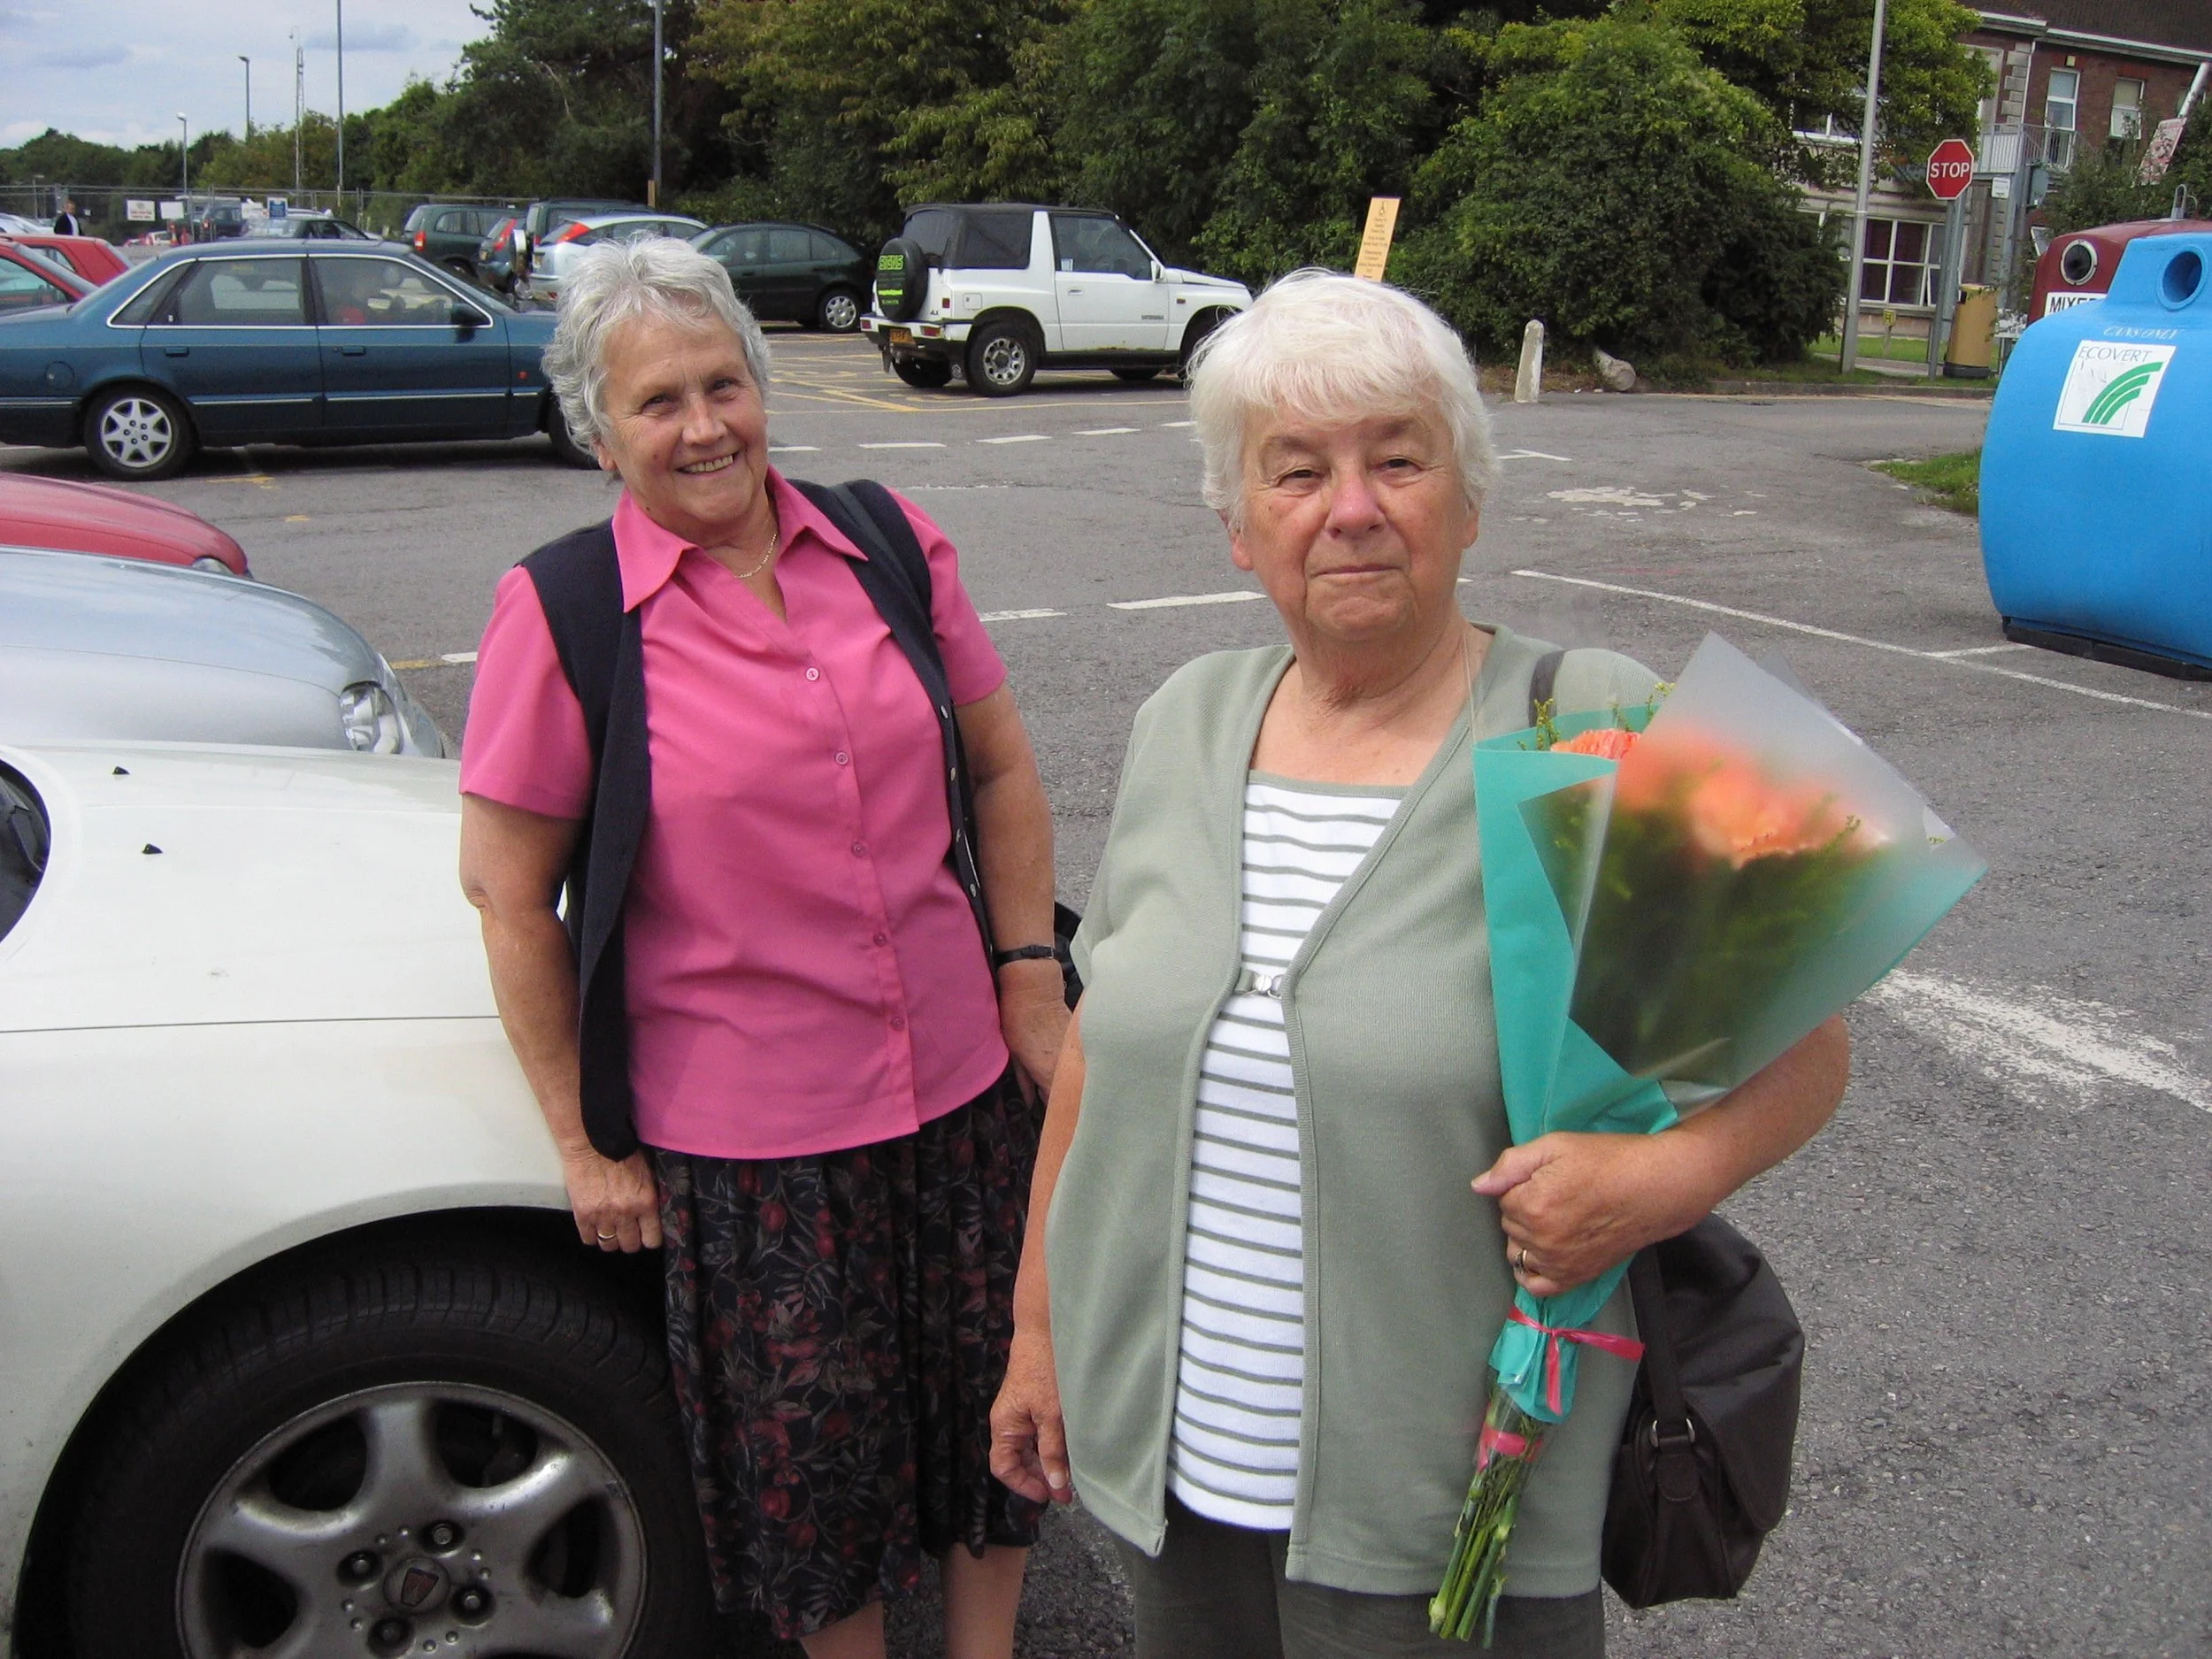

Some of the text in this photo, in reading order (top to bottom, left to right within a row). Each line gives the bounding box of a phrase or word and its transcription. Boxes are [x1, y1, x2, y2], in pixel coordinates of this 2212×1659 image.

[1930, 162, 1970, 178] STOP
[2049, 296, 2096, 313] MIX
[2078, 346, 2153, 363] ECOVERT
